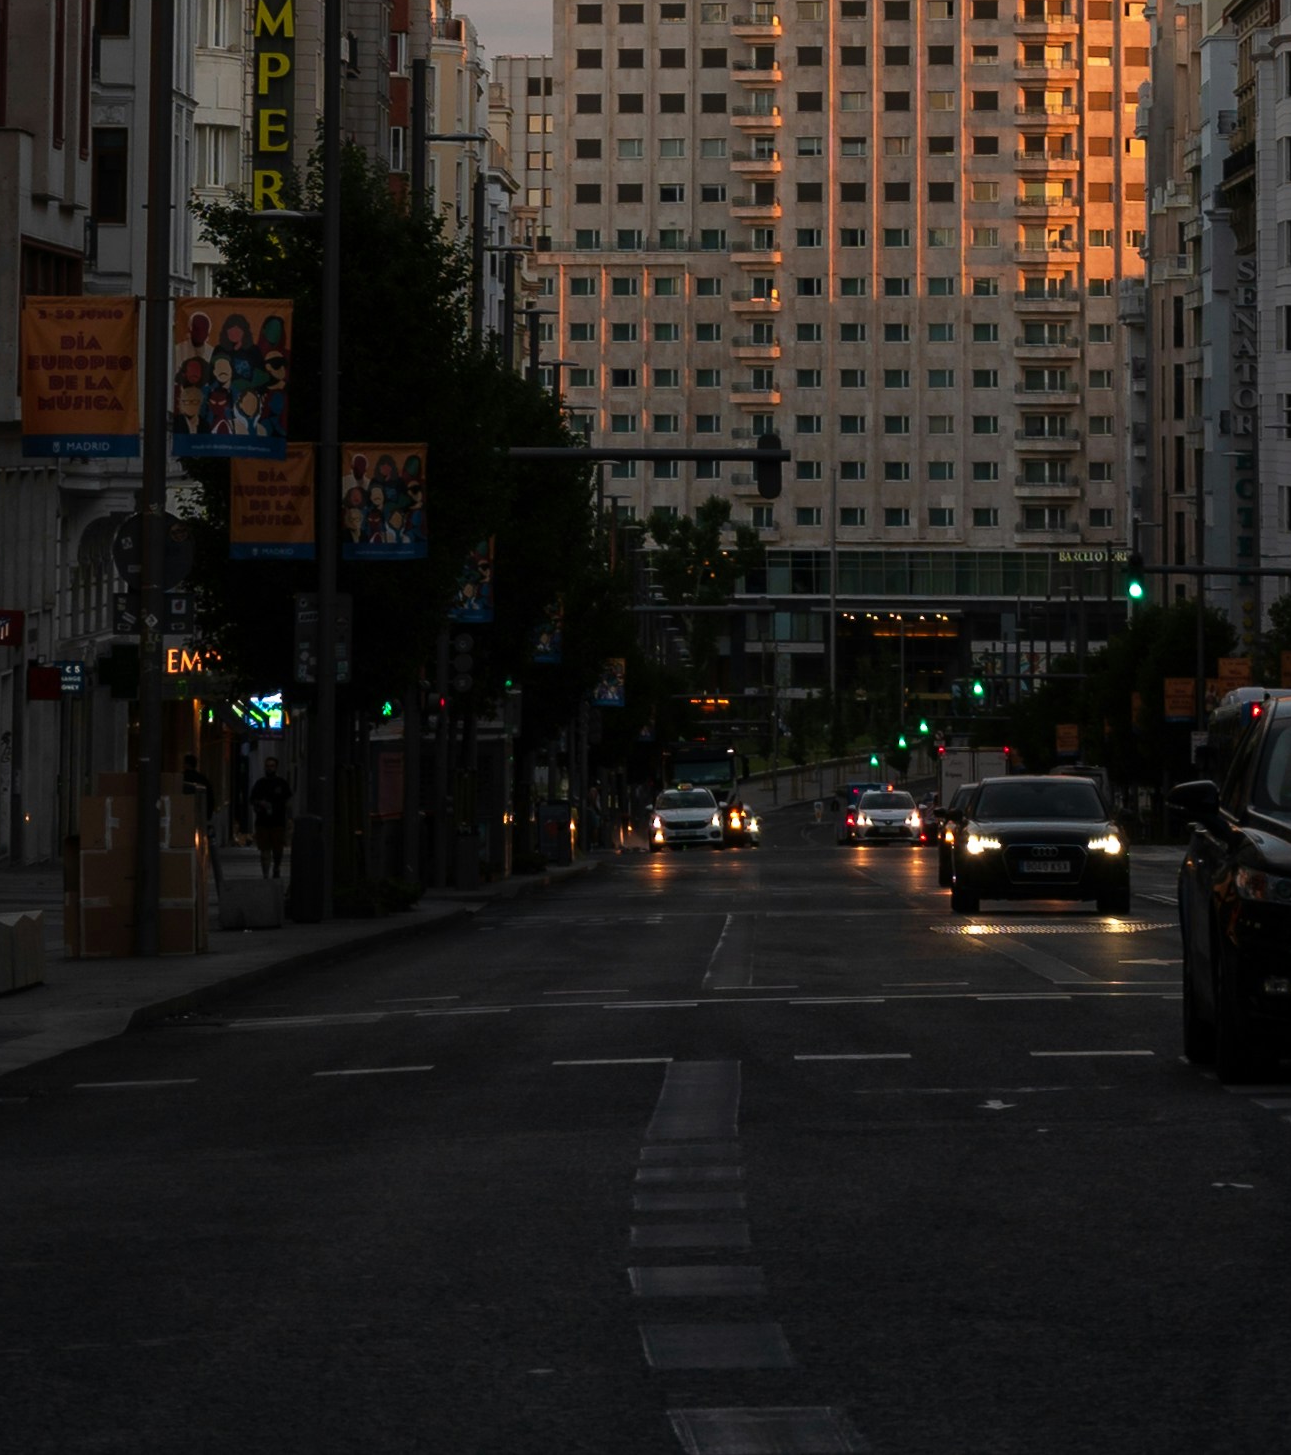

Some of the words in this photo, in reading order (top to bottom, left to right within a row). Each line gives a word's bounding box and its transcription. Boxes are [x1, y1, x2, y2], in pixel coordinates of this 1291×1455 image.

[60, 331, 102, 350] DÍA
[1233, 260, 1257, 435] SENATOR
[27, 354, 134, 371] EUROPEO
[49, 375, 79, 391] DE
[84, 375, 114, 391] LA
[37, 391, 125, 411] MÚSICA
[65, 441, 111, 452] MADRID
[261, 547, 294, 556] MADRID
